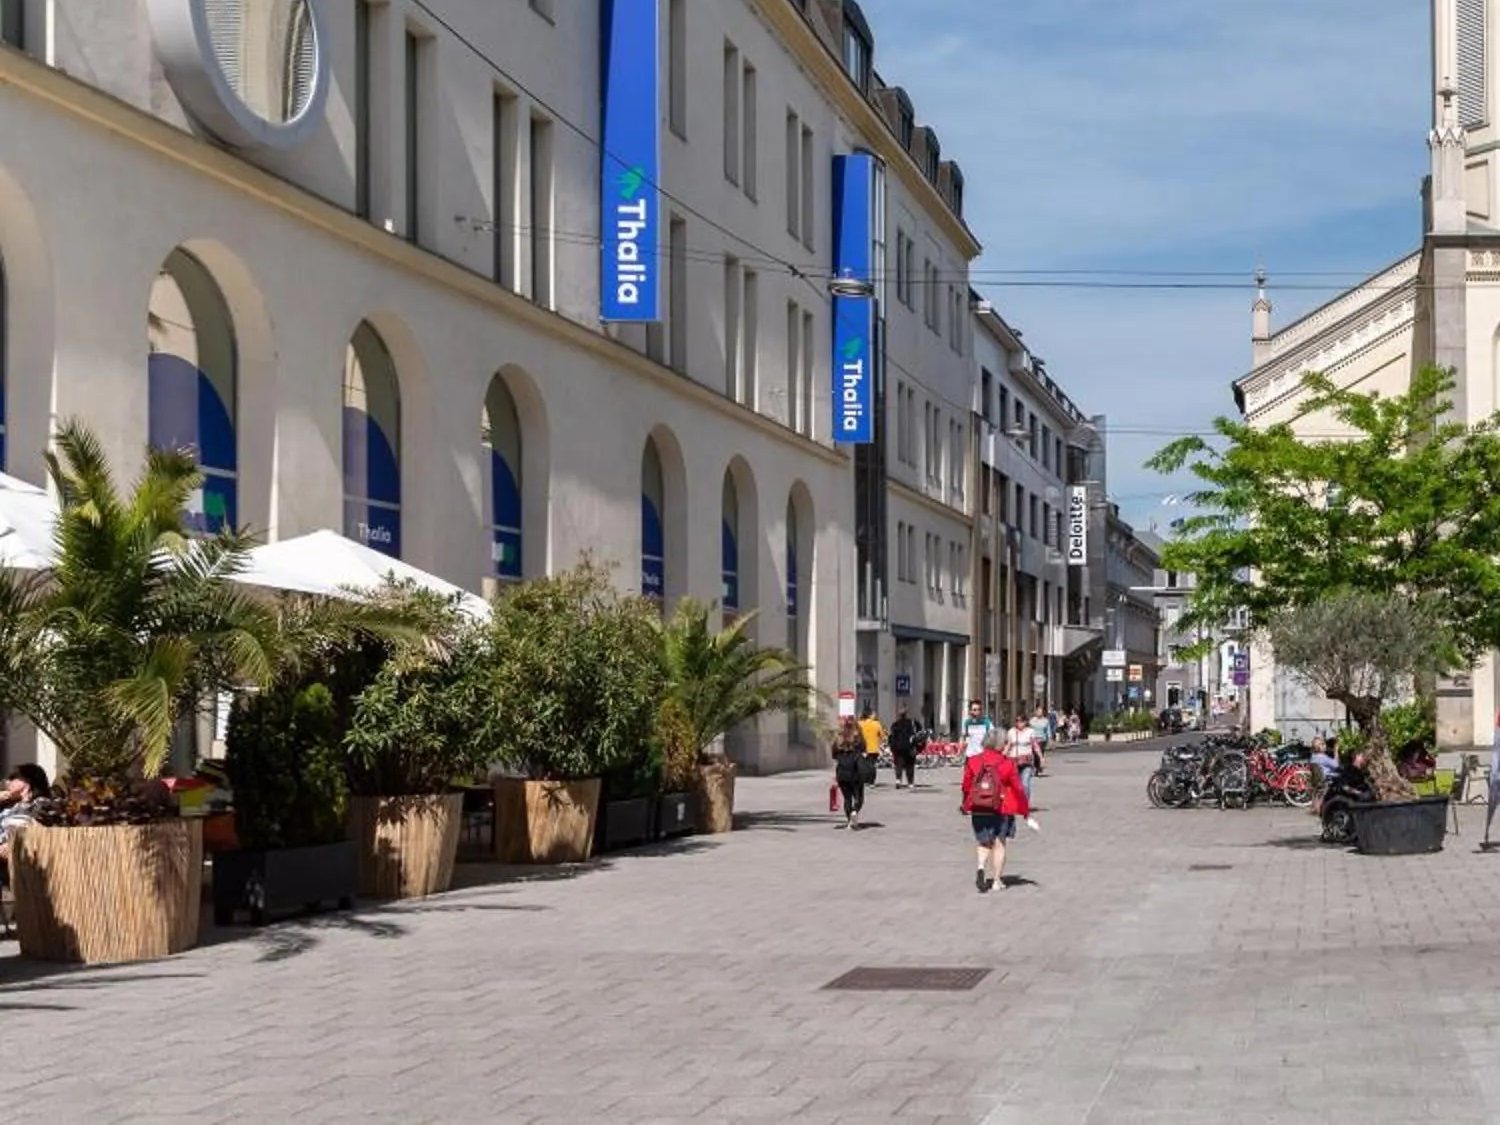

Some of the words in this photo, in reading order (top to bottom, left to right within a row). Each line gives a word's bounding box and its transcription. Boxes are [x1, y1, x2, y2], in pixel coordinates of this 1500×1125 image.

[617, 198, 647, 304] Thalia
[843, 358, 863, 432] Thalia
[358, 523, 391, 544] Thalia
